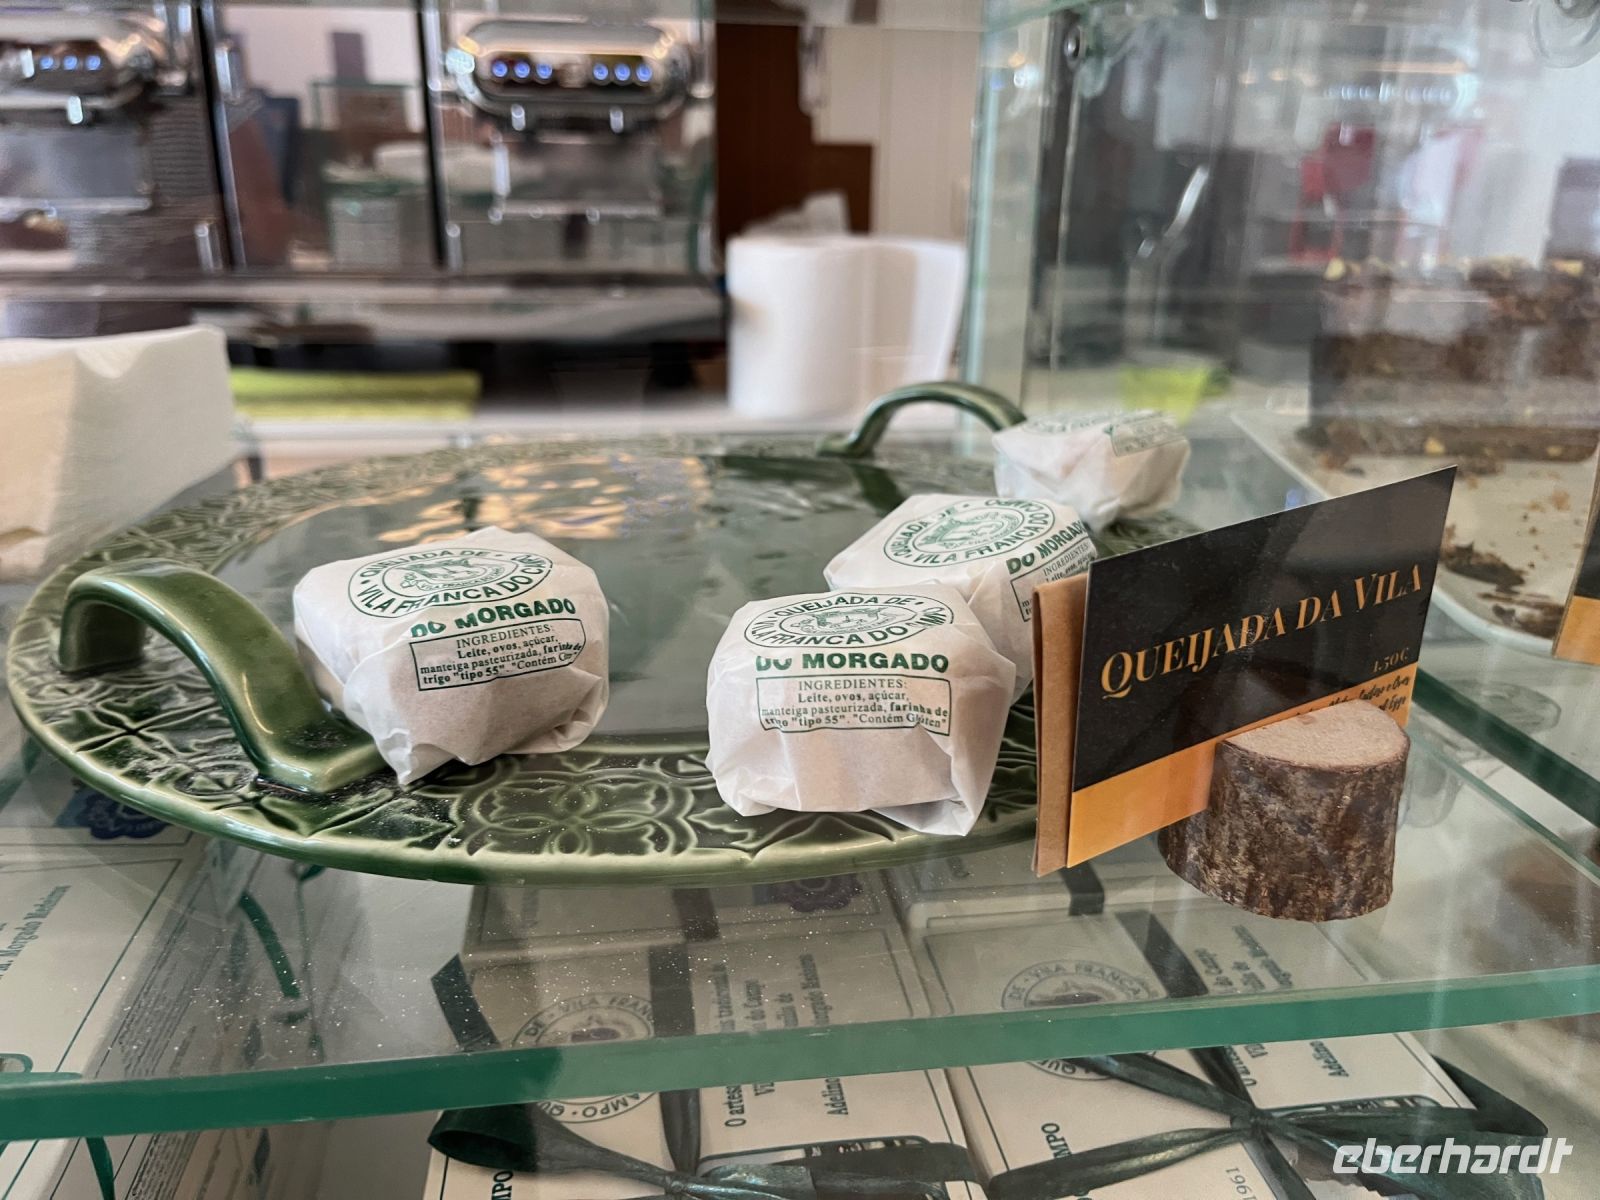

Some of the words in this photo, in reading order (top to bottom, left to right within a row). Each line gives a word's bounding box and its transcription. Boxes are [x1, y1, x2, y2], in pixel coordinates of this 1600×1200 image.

[913, 552, 958, 564] VILA
[965, 524, 1045, 559] FRANCA
[1028, 512, 1050, 526] DO
[360, 550, 450, 578] QUEIJADA
[459, 549, 492, 557] DE
[1006, 552, 1035, 575] DO
[357, 584, 396, 613] VILA
[392, 586, 500, 614] FRANCA
[498, 574, 533, 593] DO
[774, 596, 879, 617] QUEIJADA
[883, 596, 916, 605] DE
[410, 620, 447, 638] DO
[455, 598, 576, 630] MORGADO
[456, 623, 555, 649] INGREDIENTES:
[766, 628, 864, 645] FRANCA
[867, 625, 908, 642] DO
[1101, 607, 1286, 700] QUEIJADA
[1295, 590, 1343, 631] DA
[1354, 564, 1422, 611] VILA
[420, 662, 469, 676] manteiga
[802, 652, 949, 673] MORGADO
[423, 673, 451, 686] trigo
[798, 678, 909, 692] INGREDIENTES:
[761, 705, 809, 720] manteiga
[889, 702, 932, 716] farinha
[935, 706, 948, 717] de
[724, 1117, 747, 1127] O
